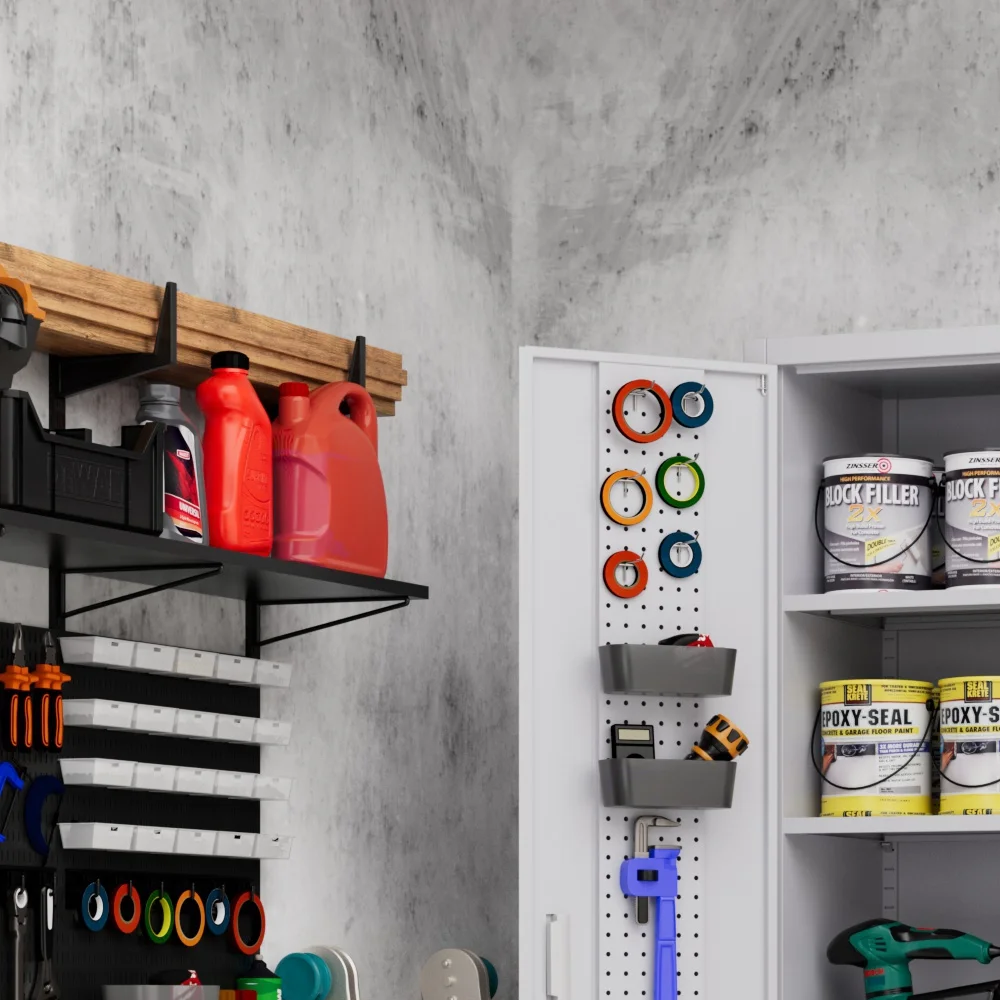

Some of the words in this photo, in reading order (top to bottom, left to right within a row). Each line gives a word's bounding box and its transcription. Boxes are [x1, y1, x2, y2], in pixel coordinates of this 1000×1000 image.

[825, 484, 863, 507] BLOCK
[866, 484, 919, 506] FILLER
[946, 478, 986, 502] BLOCK
[867, 539, 886, 551] DOUBLE
[847, 684, 868, 694] SEAL
[967, 681, 989, 690] SEAL
[967, 689, 989, 697] KRETE
[822, 709, 912, 727] EPOXY-SEAL
